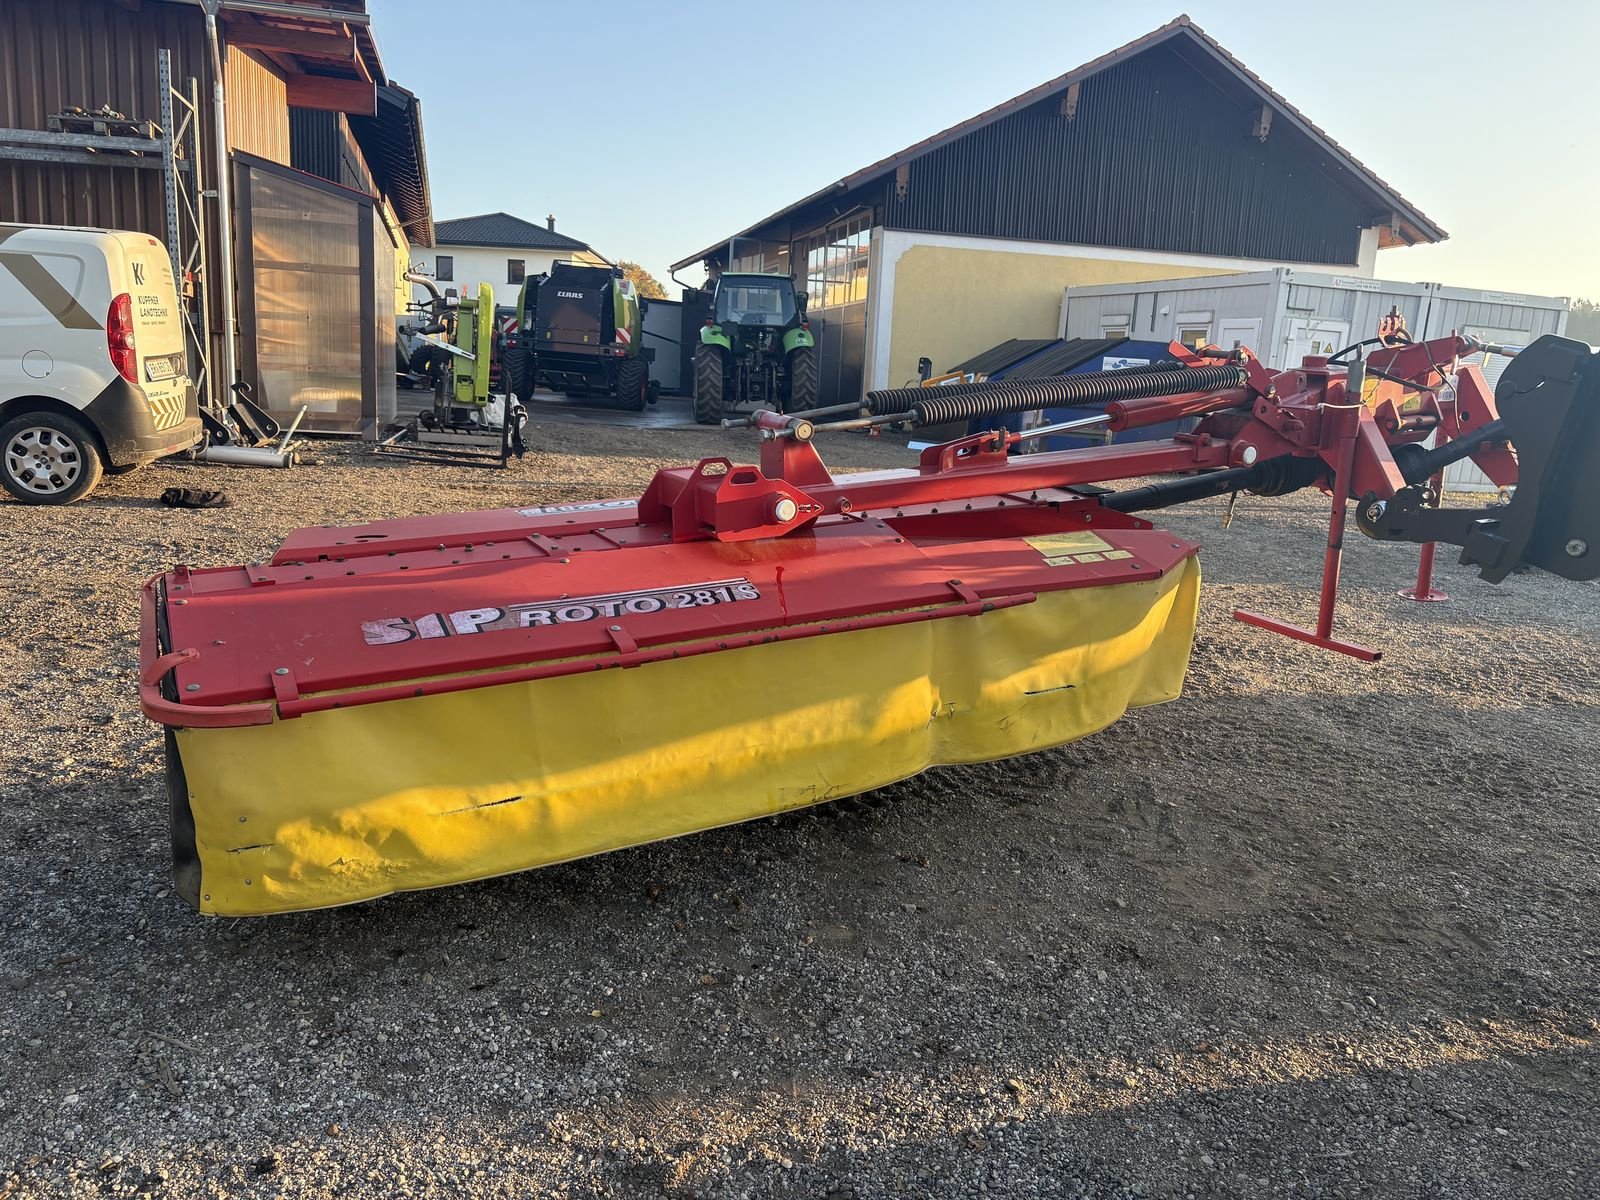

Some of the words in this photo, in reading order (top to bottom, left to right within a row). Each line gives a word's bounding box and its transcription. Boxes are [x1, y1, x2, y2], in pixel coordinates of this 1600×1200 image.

[557, 291, 584, 299] CLAAS
[360, 607, 505, 646] SIP
[519, 597, 667, 628] ROTO
